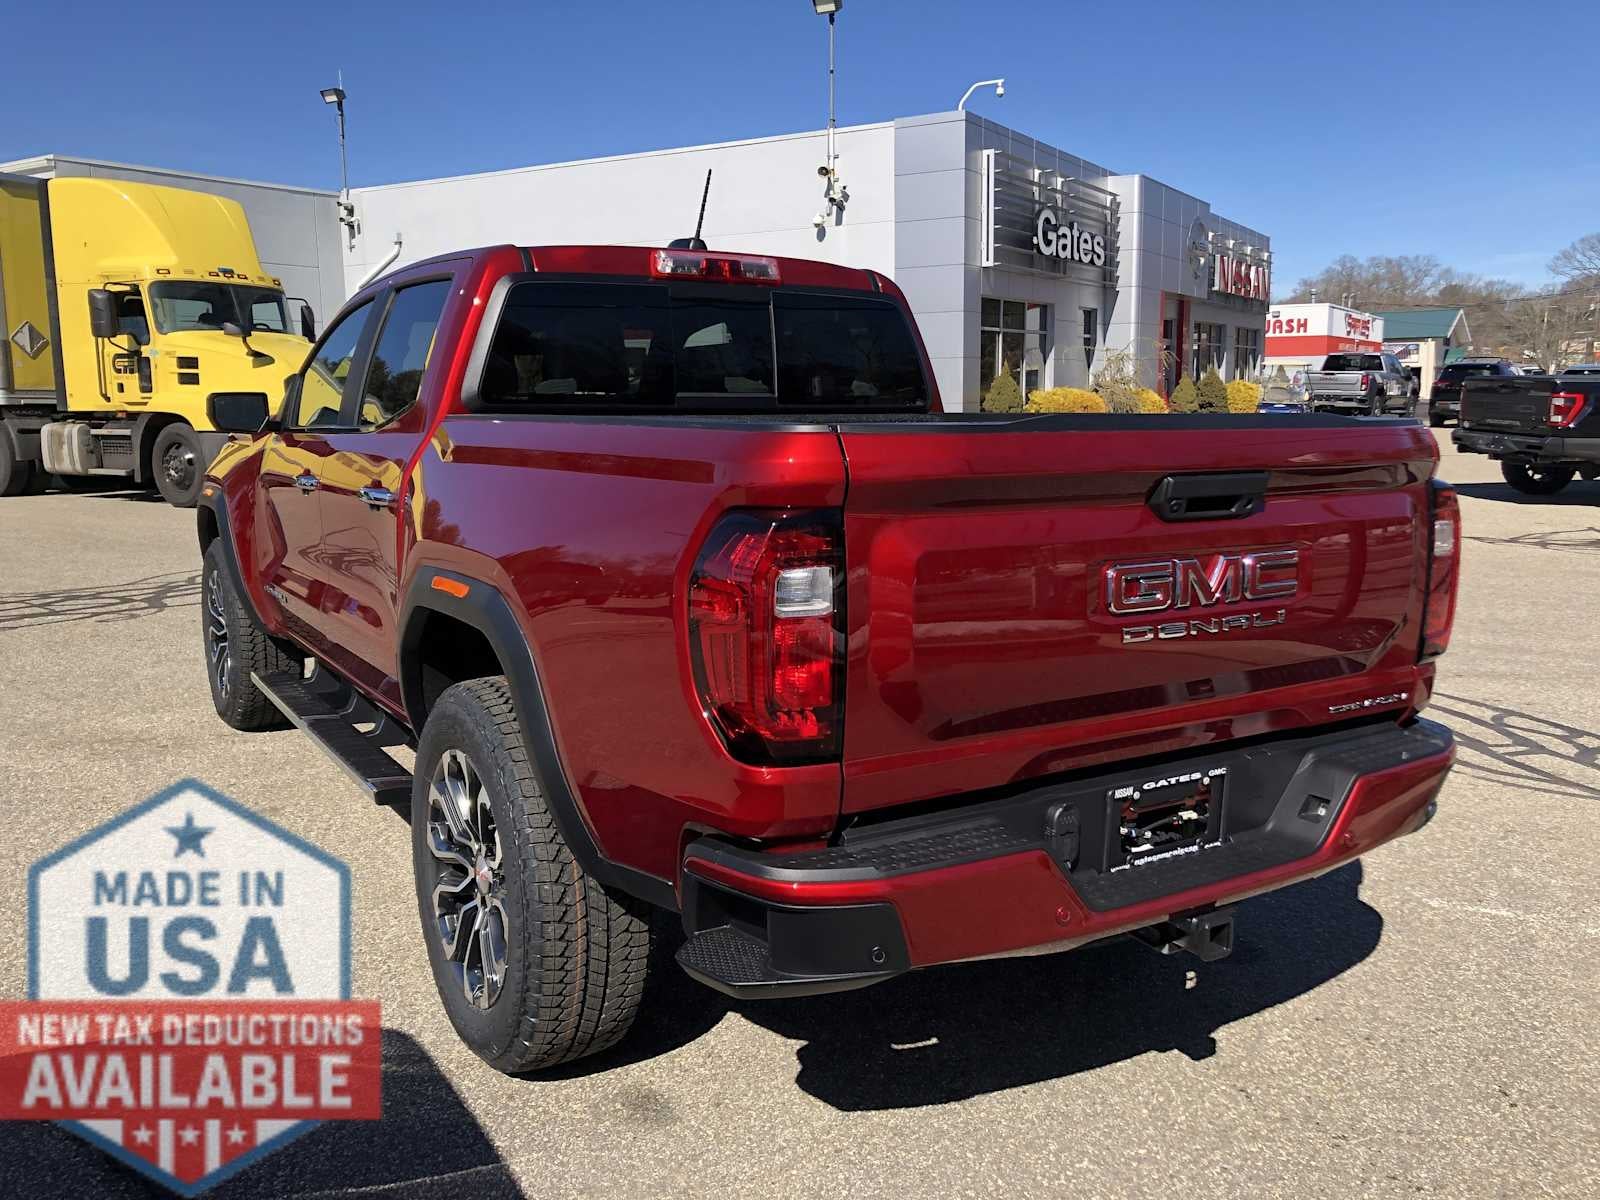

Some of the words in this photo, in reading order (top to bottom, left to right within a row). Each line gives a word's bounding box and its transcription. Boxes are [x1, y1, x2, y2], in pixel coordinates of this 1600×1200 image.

[1038, 209, 1105, 266] Gates
[1213, 254, 1270, 301] NISSAN
[1106, 548, 1299, 615] GMC
[1121, 608, 1287, 644] DENALI
[1114, 786, 1132, 800] NISSAN
[1142, 772, 1202, 790] GATES
[1208, 767, 1227, 777] GMC
